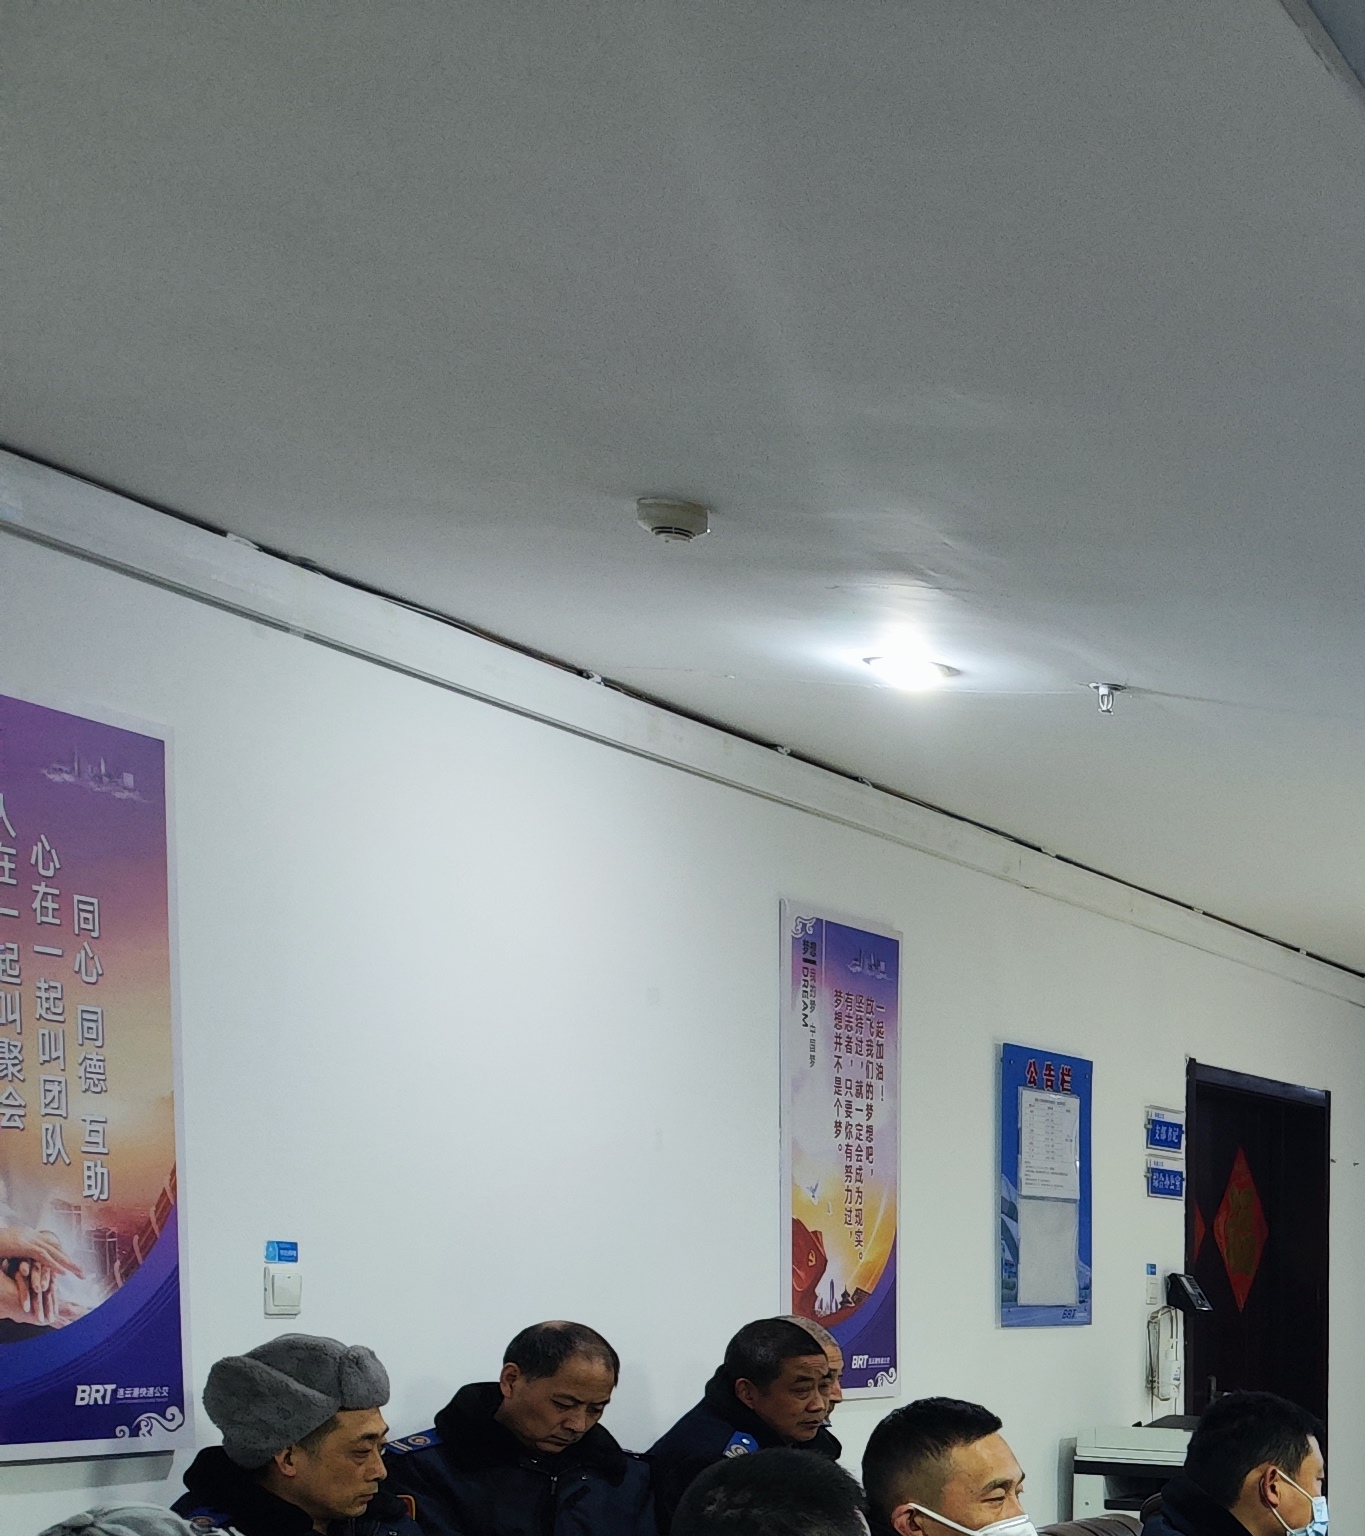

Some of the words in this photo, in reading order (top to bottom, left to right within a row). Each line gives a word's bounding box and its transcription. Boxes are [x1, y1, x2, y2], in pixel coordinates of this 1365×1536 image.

[73, 893, 103, 985] 同心
[30, 834, 71, 1166] 心在一起叫团队
[76, 1004, 107, 1095] 同德
[1025, 1059, 1072, 1094] 公告栏
[81, 1113, 109, 1202] 互助
[75, 1383, 117, 1406] BRT
[851, 1354, 869, 1369] BRT
